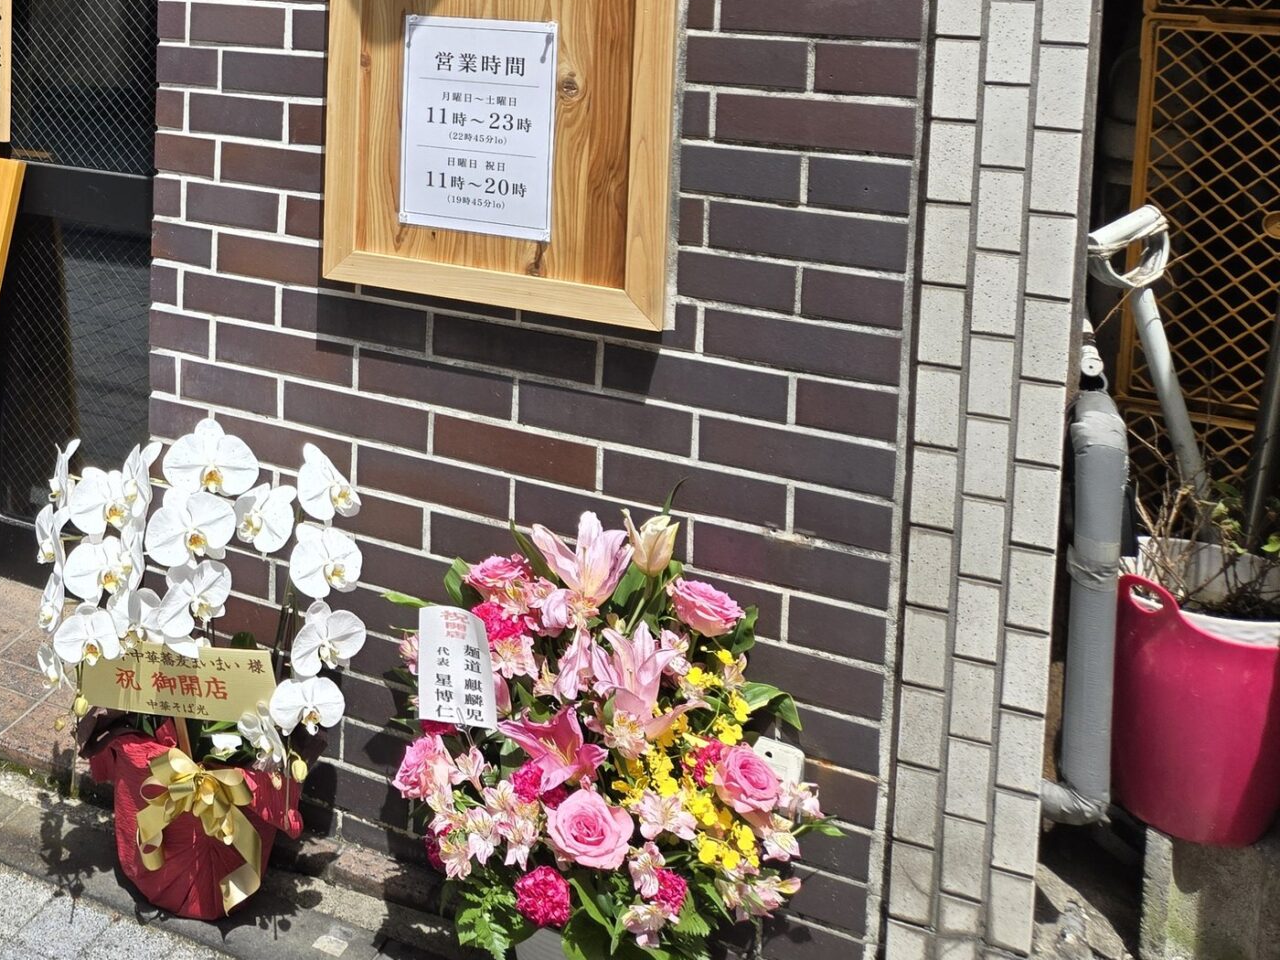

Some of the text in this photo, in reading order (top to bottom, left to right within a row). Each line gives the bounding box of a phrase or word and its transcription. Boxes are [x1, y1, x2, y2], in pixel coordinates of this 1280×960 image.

[435, 51, 526, 77] 営業時間
[447, 157, 506, 172] 日曜日 祝日
[121, 648, 266, 675] 中華蕎麦まいまい 様
[116, 668, 228, 701] 祝 御開店
[435, 646, 454, 719] 代表 星博仁
[145, 699, 210, 716] 中華そば光
